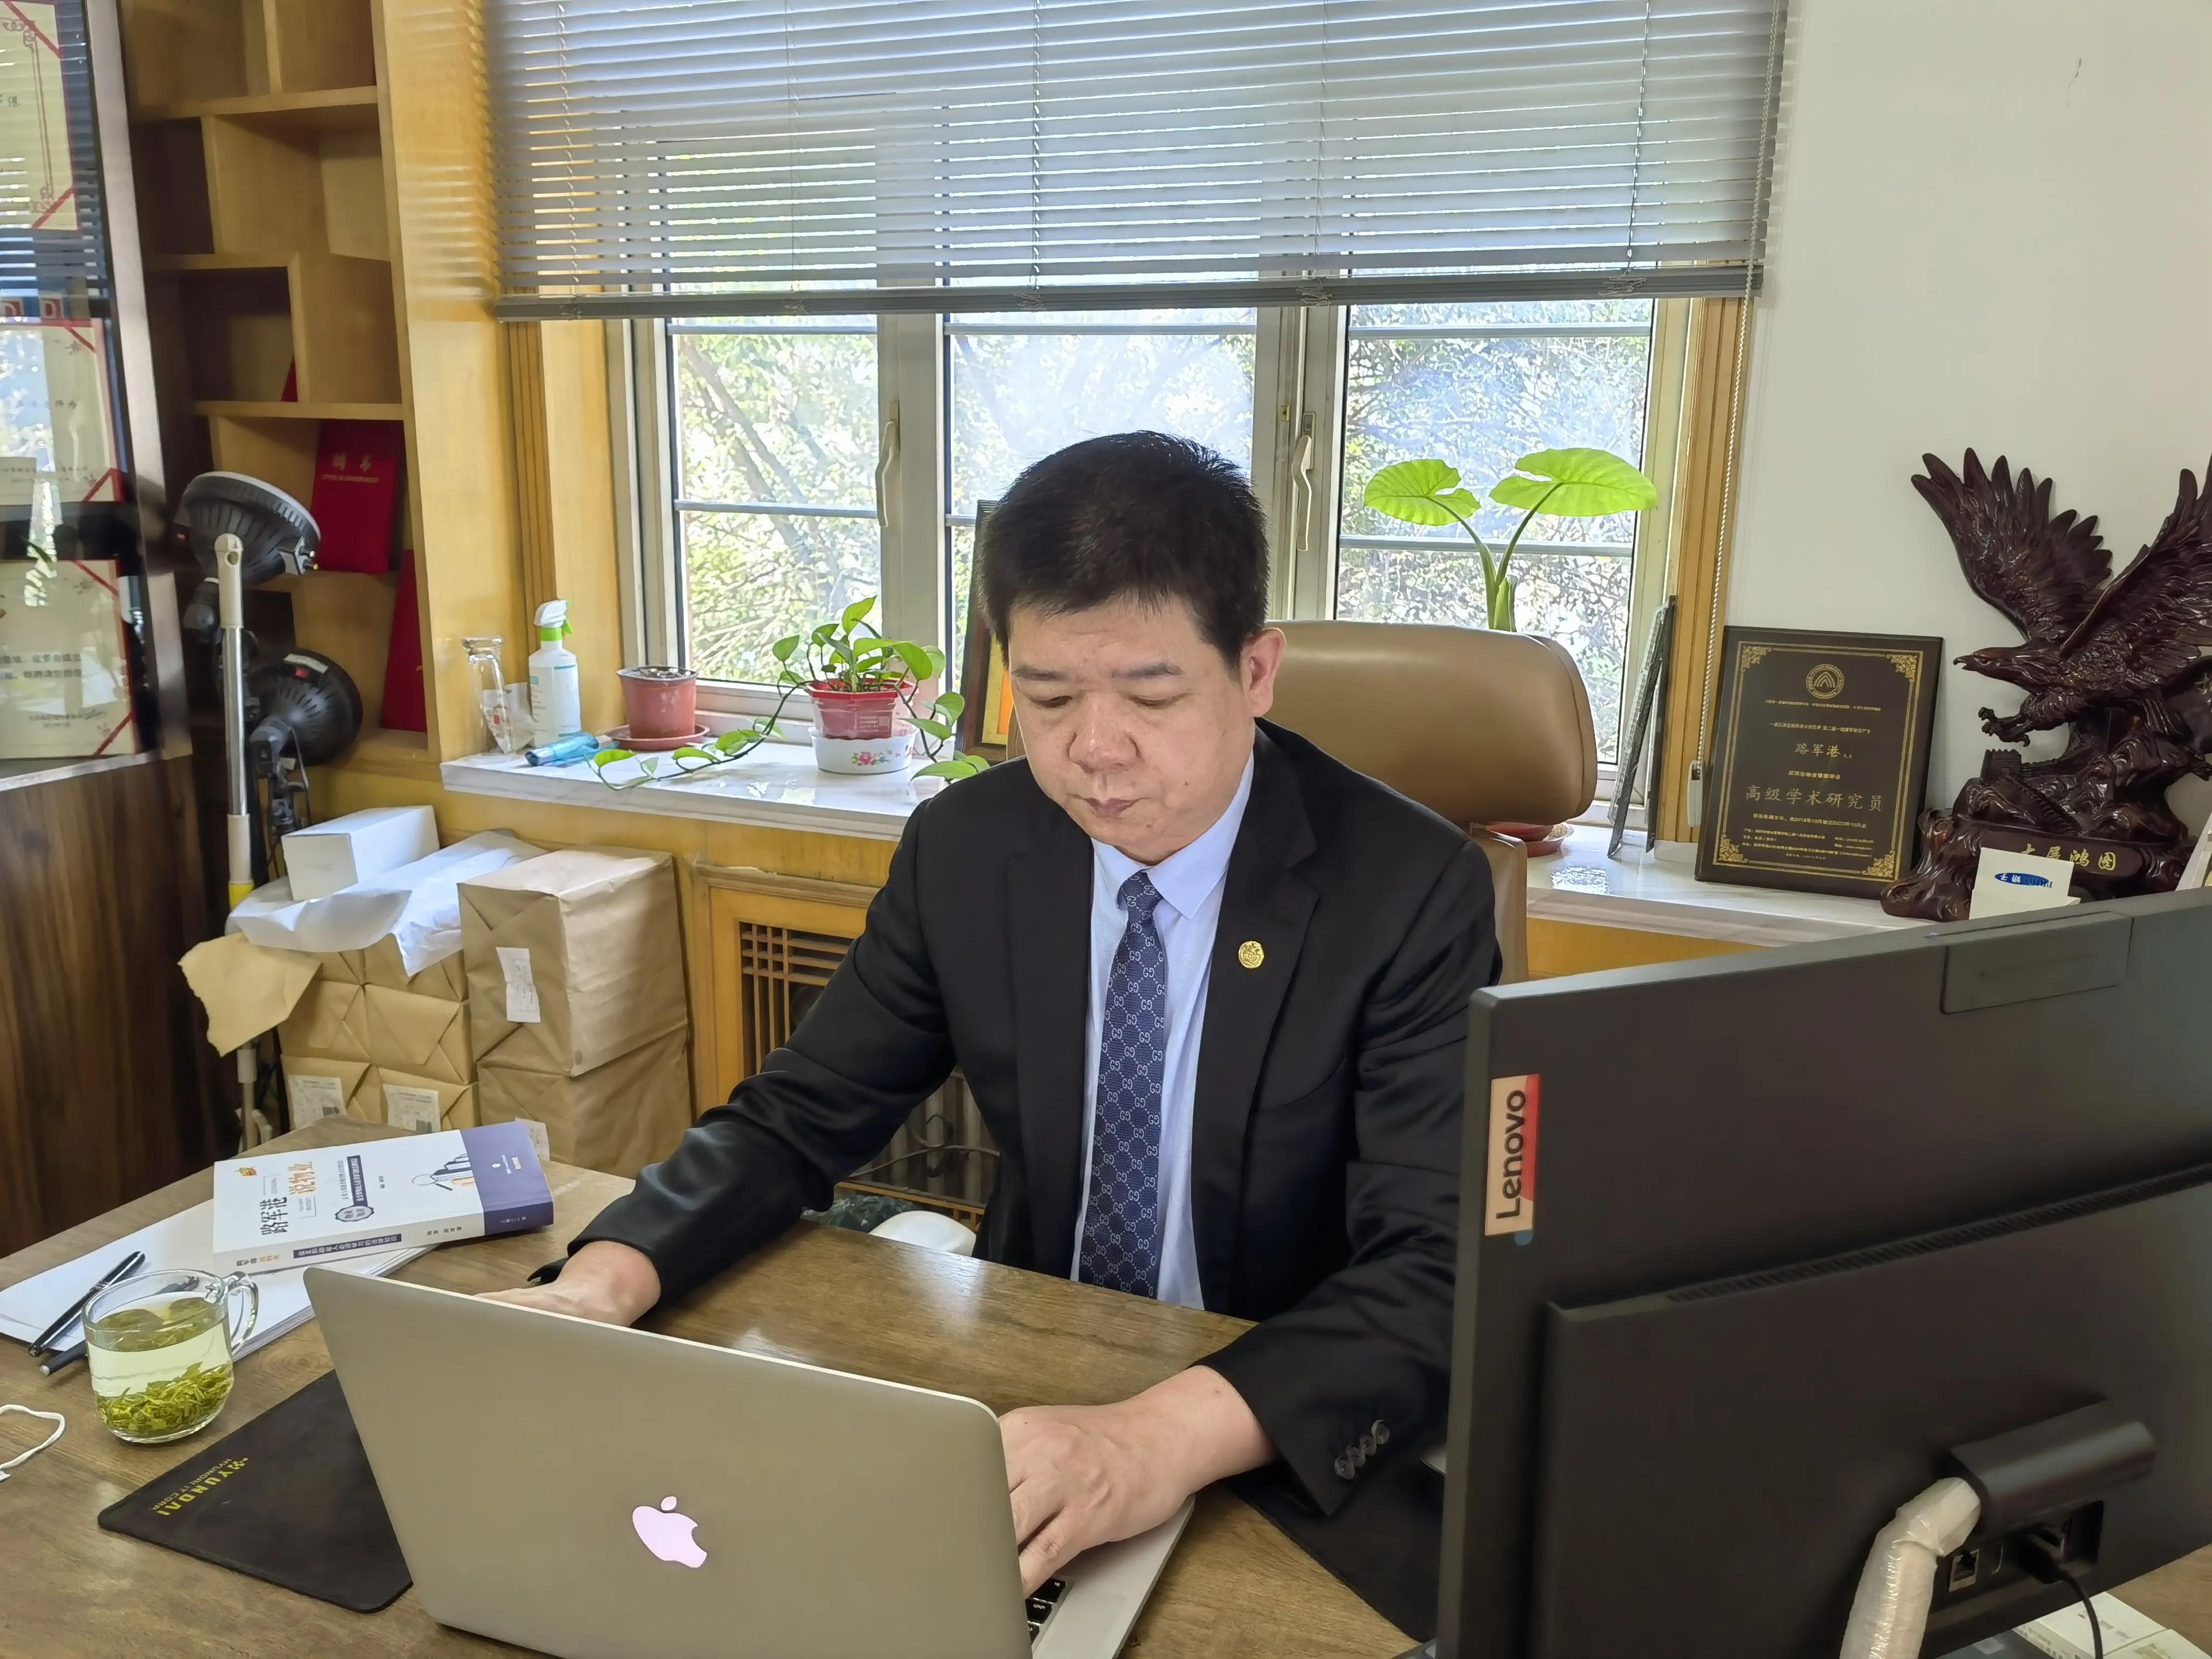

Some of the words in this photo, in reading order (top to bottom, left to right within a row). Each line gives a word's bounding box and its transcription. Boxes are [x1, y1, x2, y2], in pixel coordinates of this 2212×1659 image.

[1794, 743, 1841, 758] 路军港
[1745, 784, 1883, 812] 高级学术研究员
[1495, 1089, 1526, 1219] Lenovo
[260, 1196, 288, 1235] 路军港
